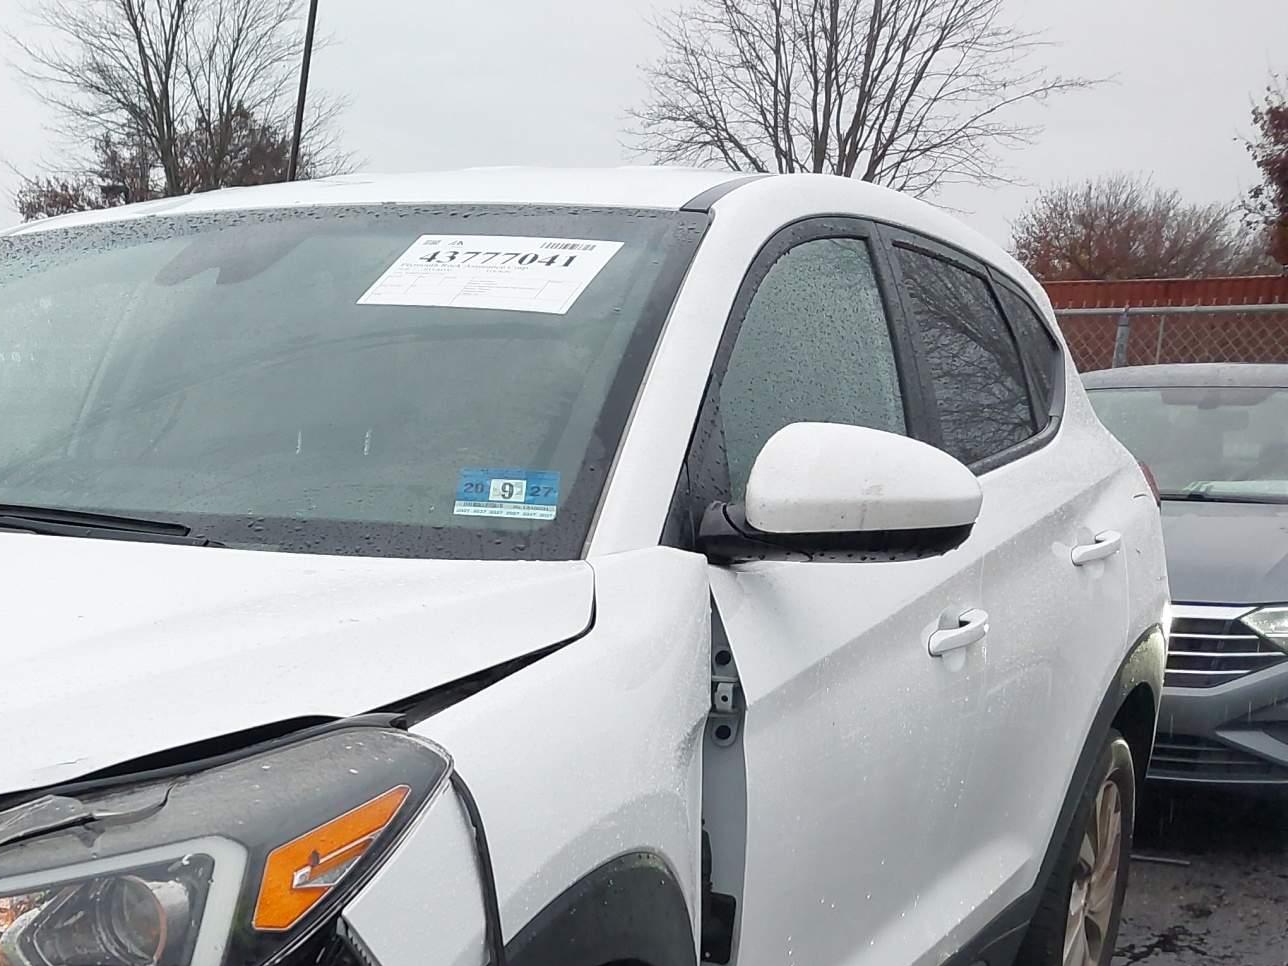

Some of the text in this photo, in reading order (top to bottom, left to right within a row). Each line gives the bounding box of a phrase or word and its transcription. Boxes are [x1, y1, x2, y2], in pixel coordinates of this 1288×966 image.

[418, 250, 577, 267] 43777041
[463, 482, 553, 499] 20 9 27
